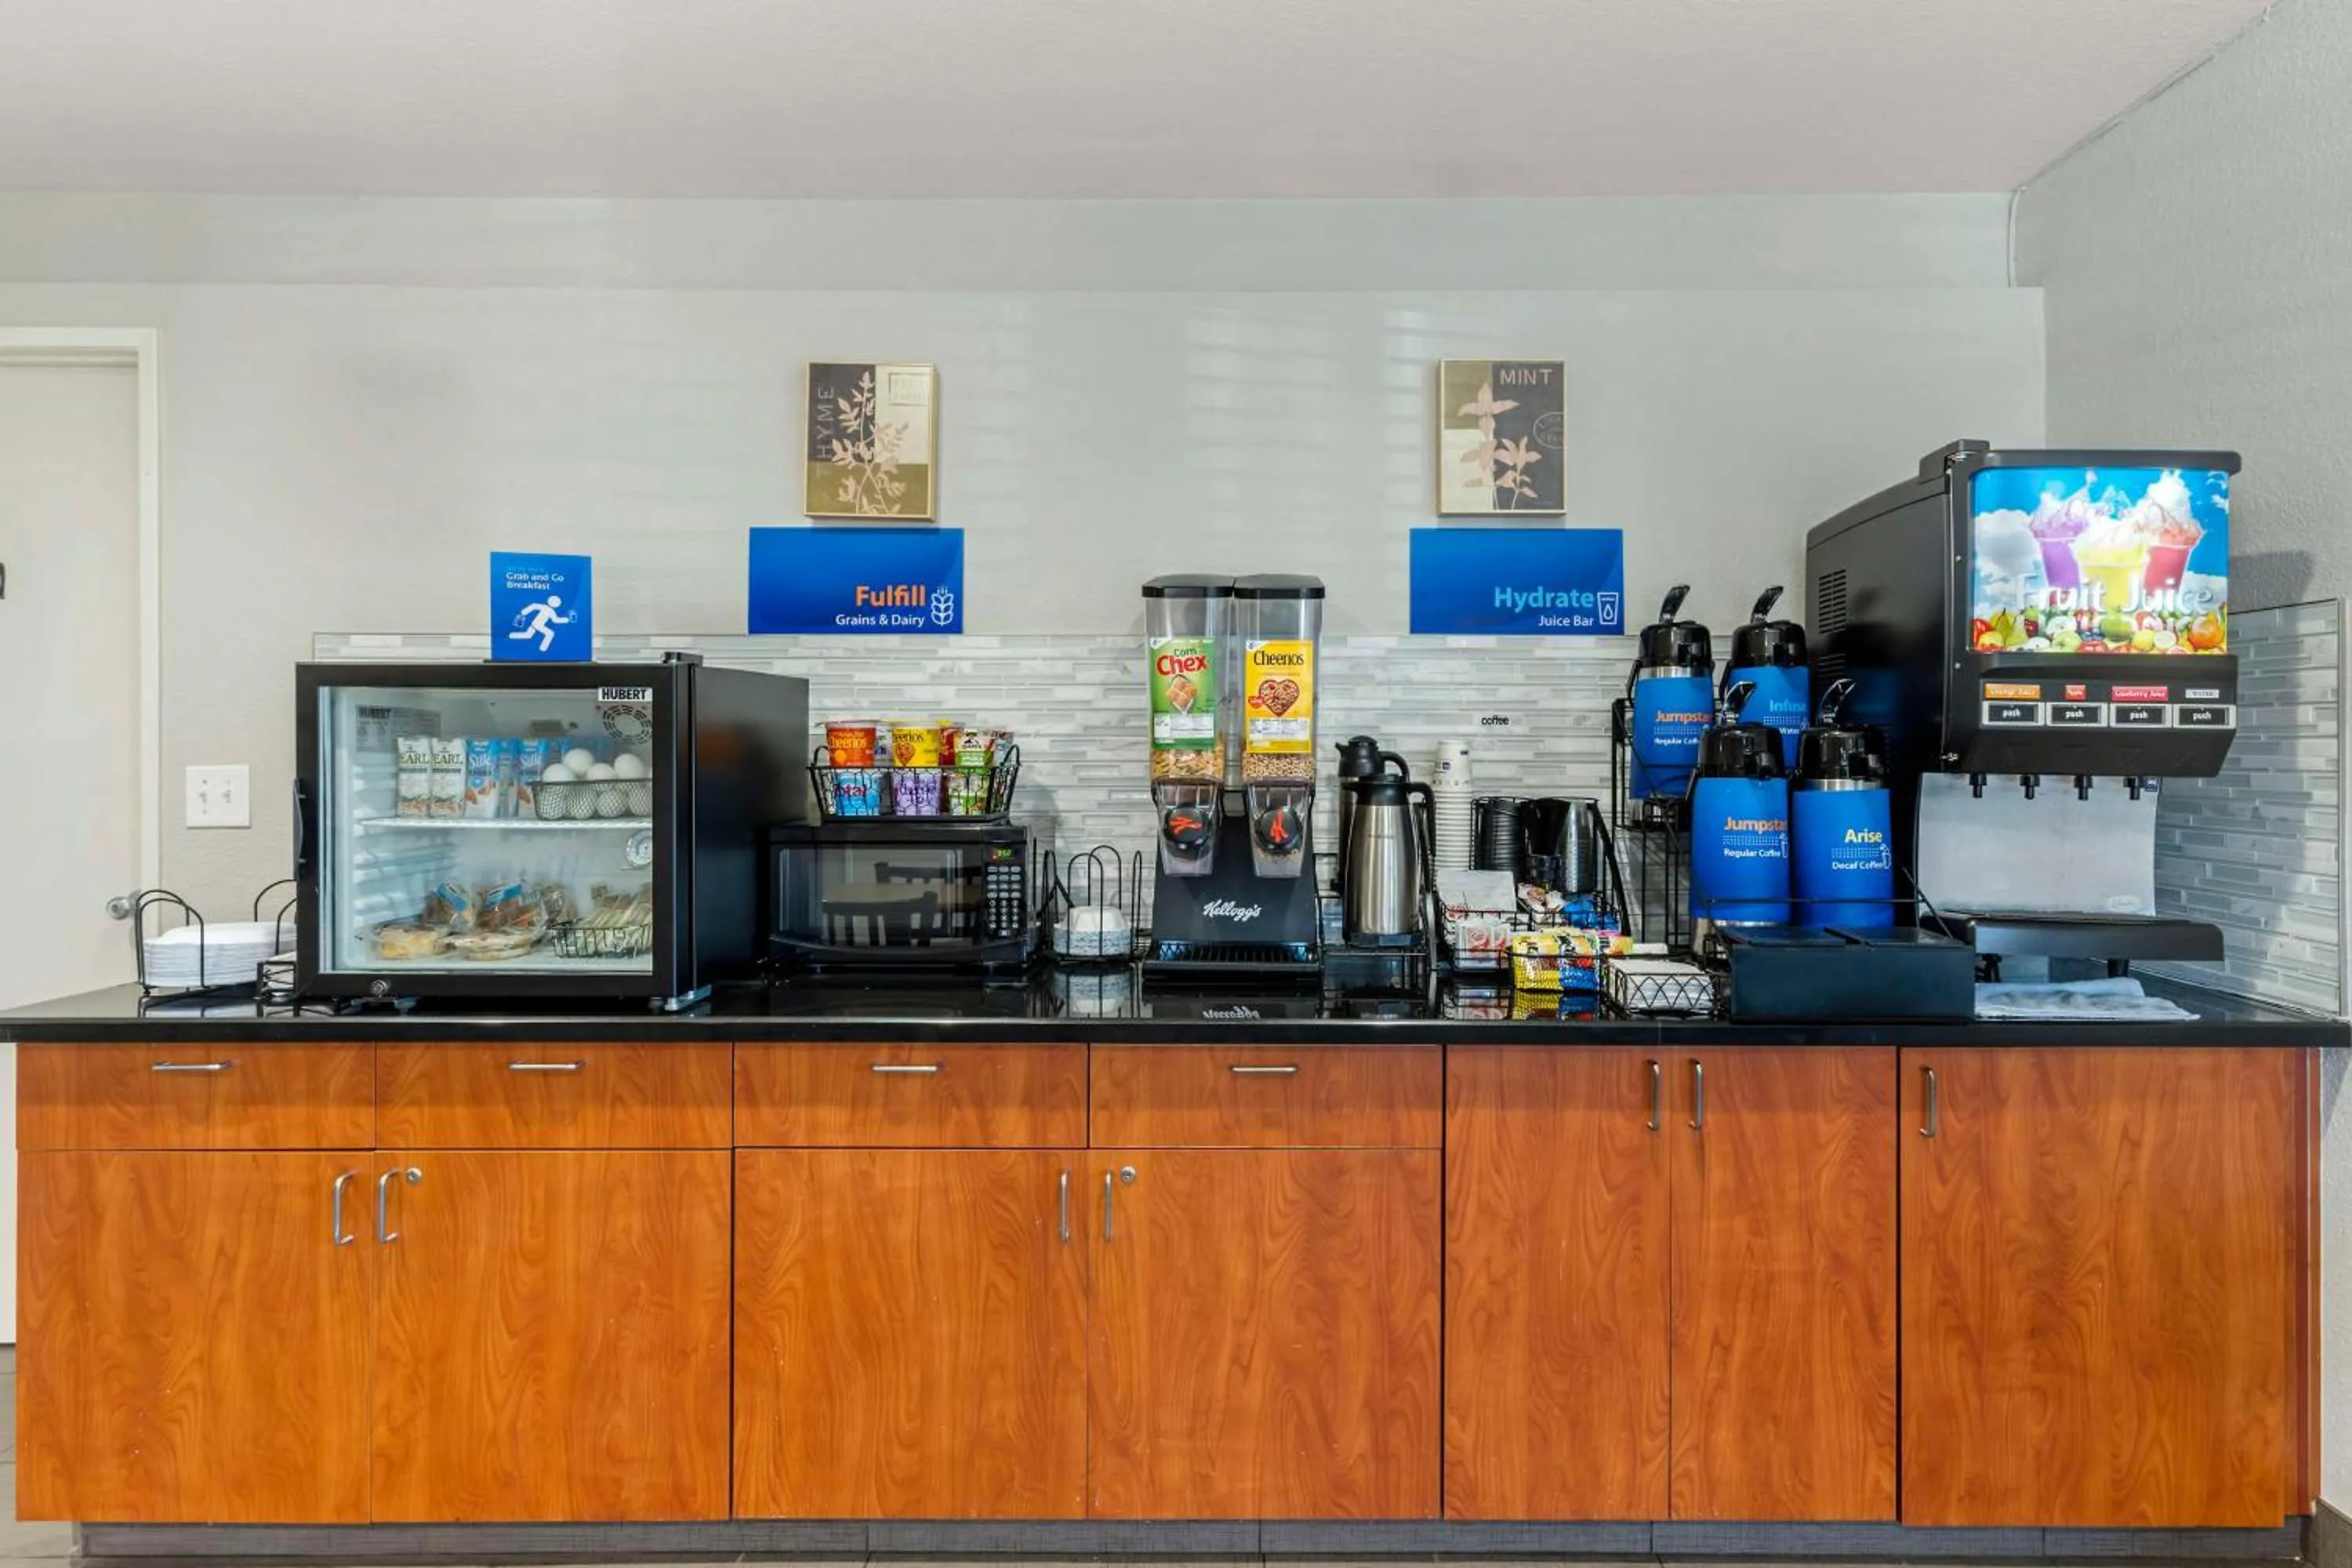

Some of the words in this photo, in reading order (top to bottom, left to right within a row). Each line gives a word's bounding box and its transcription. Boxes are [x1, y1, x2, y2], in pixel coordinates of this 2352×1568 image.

[1499, 368, 1553, 386] MINT
[506, 572, 529, 581] Grab
[531, 573, 549, 582] and
[551, 573, 564, 583] Go
[506, 581, 551, 590] Breakfast
[855, 584, 926, 606] Fulfill
[1494, 586, 1595, 613] Hydrate
[835, 614, 876, 626] Grains
[879, 615, 888, 626] &
[891, 614, 925, 628] Dairy
[1538, 615, 1570, 627] Juice
[1573, 615, 1595, 626] Bar
[1174, 648, 1197, 657] Corn
[1254, 650, 1305, 666] Cheerios
[1156, 654, 1209, 676] Chex
[601, 688, 647, 700] HUBERT
[2002, 709, 2020, 718] push
[2065, 710, 2085, 719] push
[2129, 711, 2148, 720] push
[2193, 712, 2212, 720] push
[1481, 715, 1509, 725] coffee
[1845, 828, 1882, 843] Arise
[1724, 848, 1757, 858] Regular
[1203, 899, 1262, 922] Kellogg's
